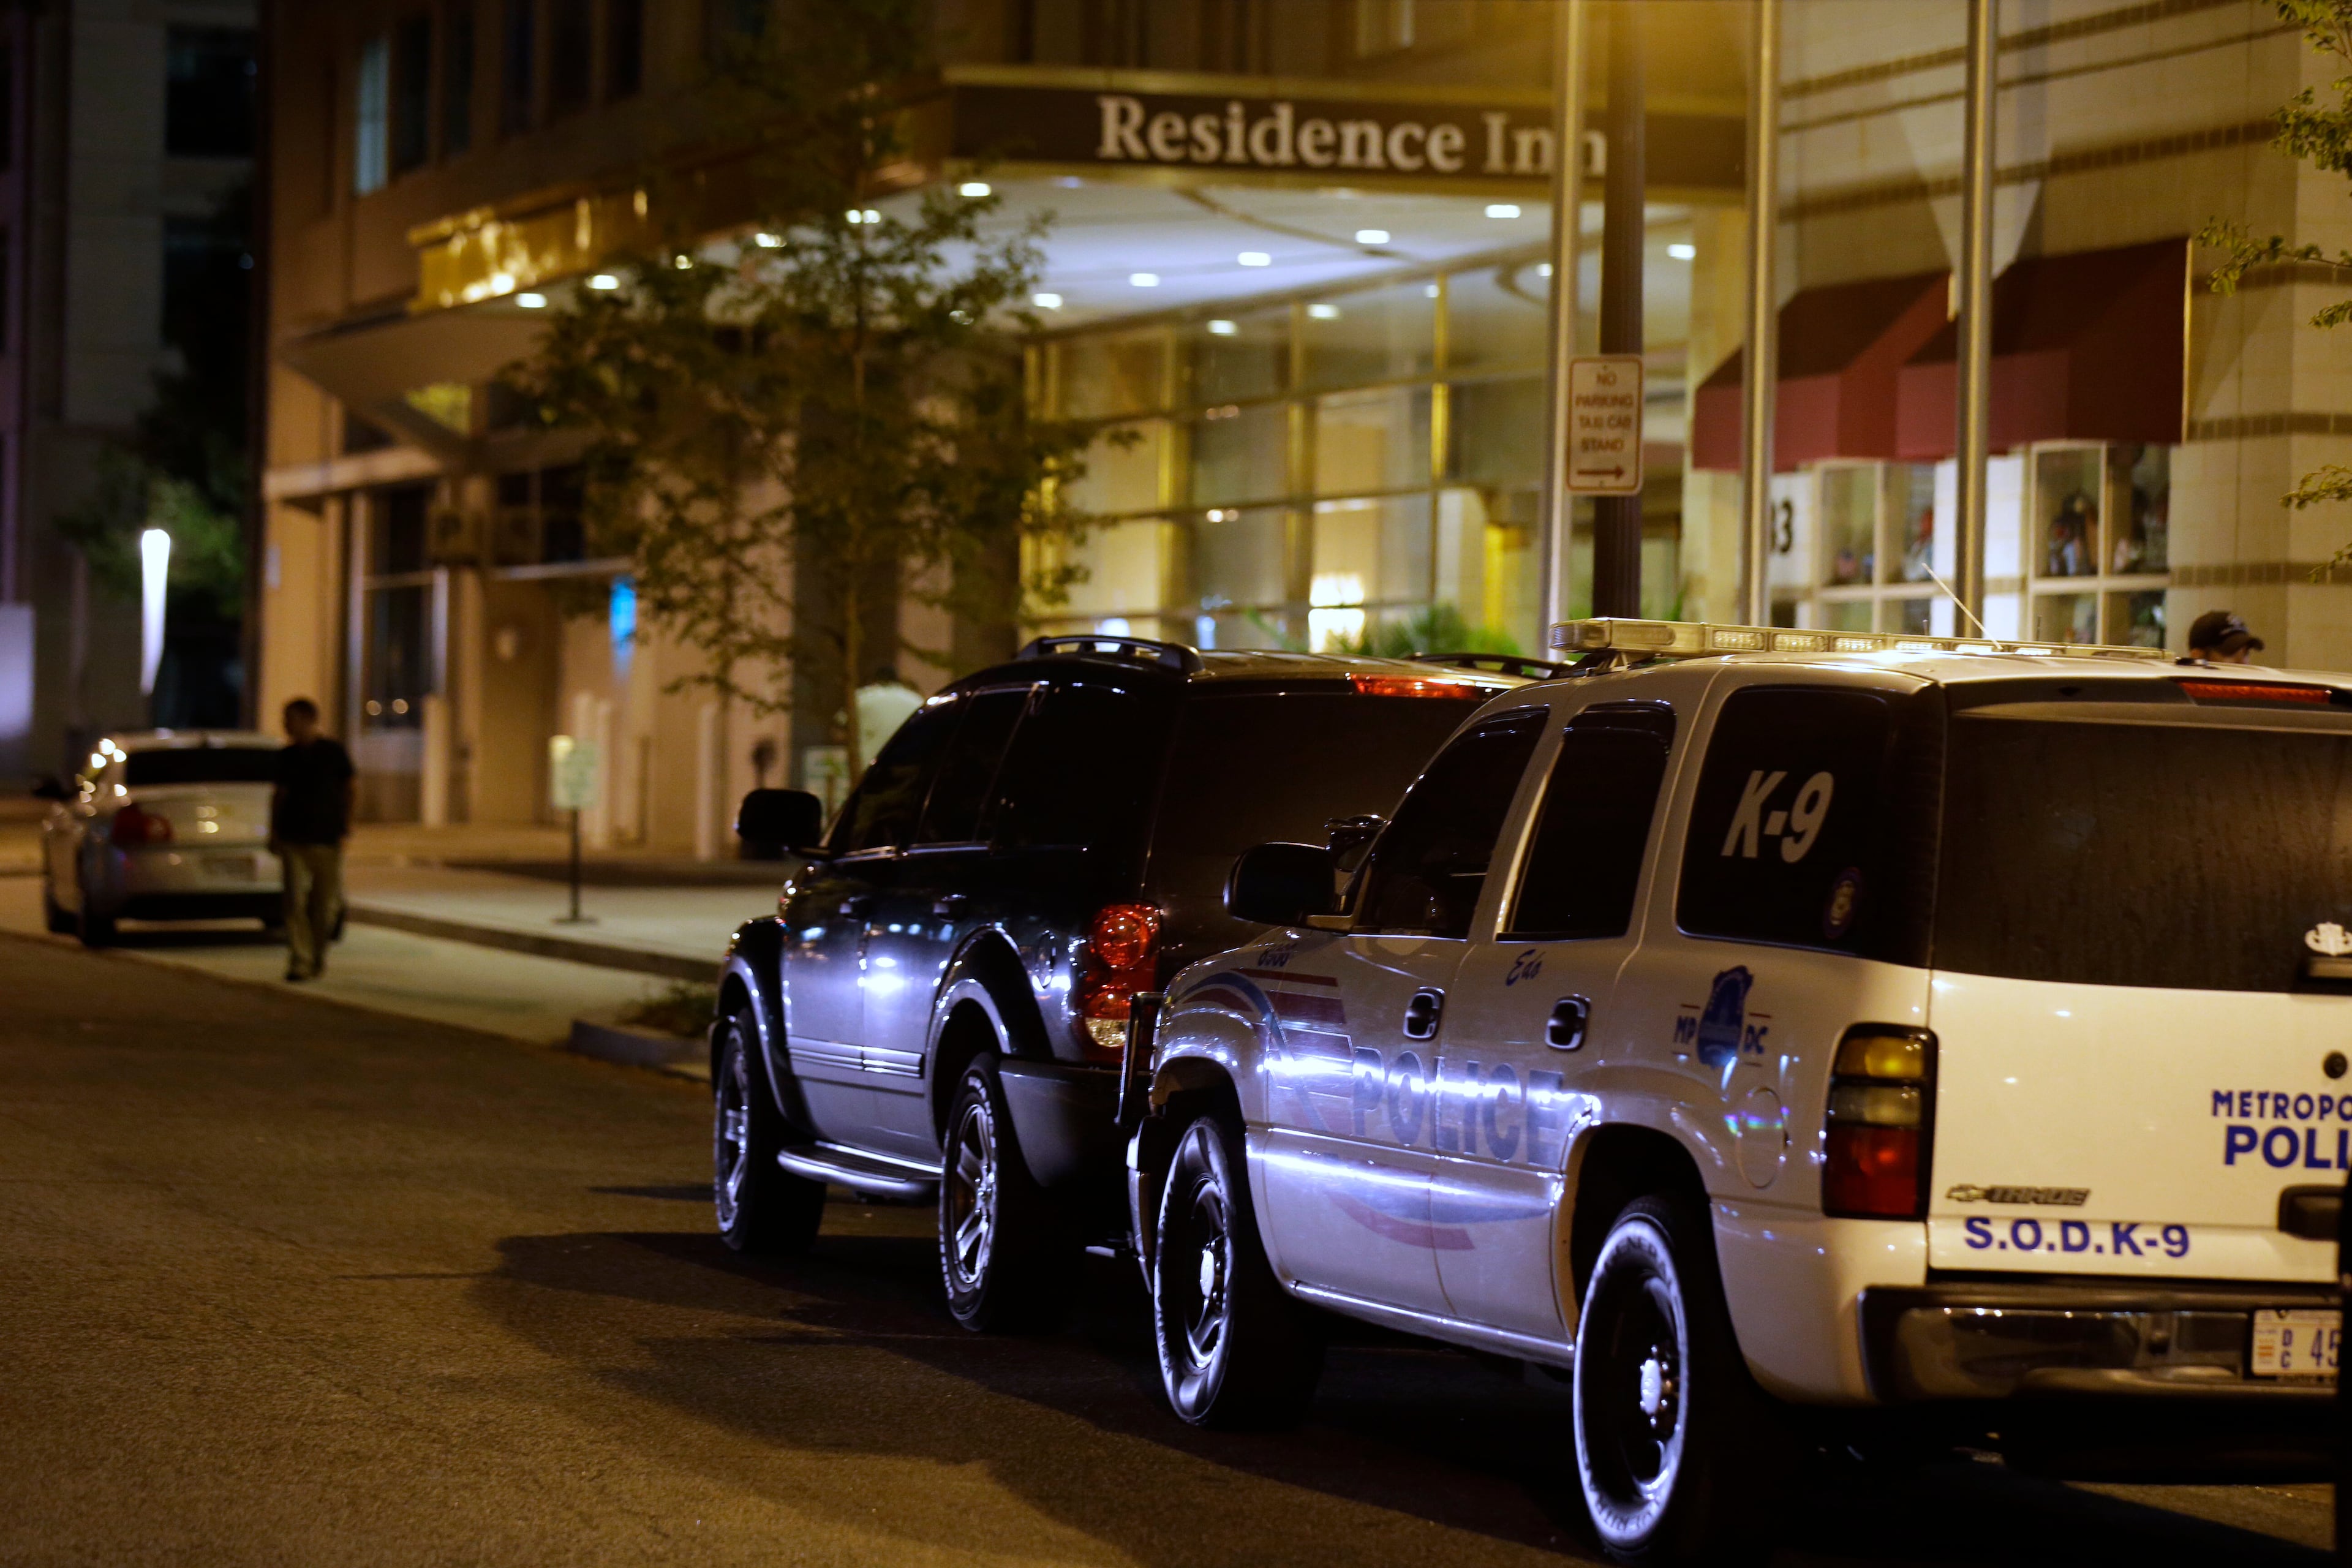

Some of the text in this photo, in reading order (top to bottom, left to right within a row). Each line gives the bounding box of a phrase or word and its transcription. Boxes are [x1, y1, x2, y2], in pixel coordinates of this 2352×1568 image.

[1096, 96, 1466, 172] Residence
[1596, 372, 1617, 386] NO
[1575, 394, 1634, 409] PARKING
[1580, 414, 1632, 429] TAXI CAB
[1581, 437, 1624, 453] STAND
[1721, 770, 1834, 864] K-9
[1351, 1046, 1564, 1167] POLICE
